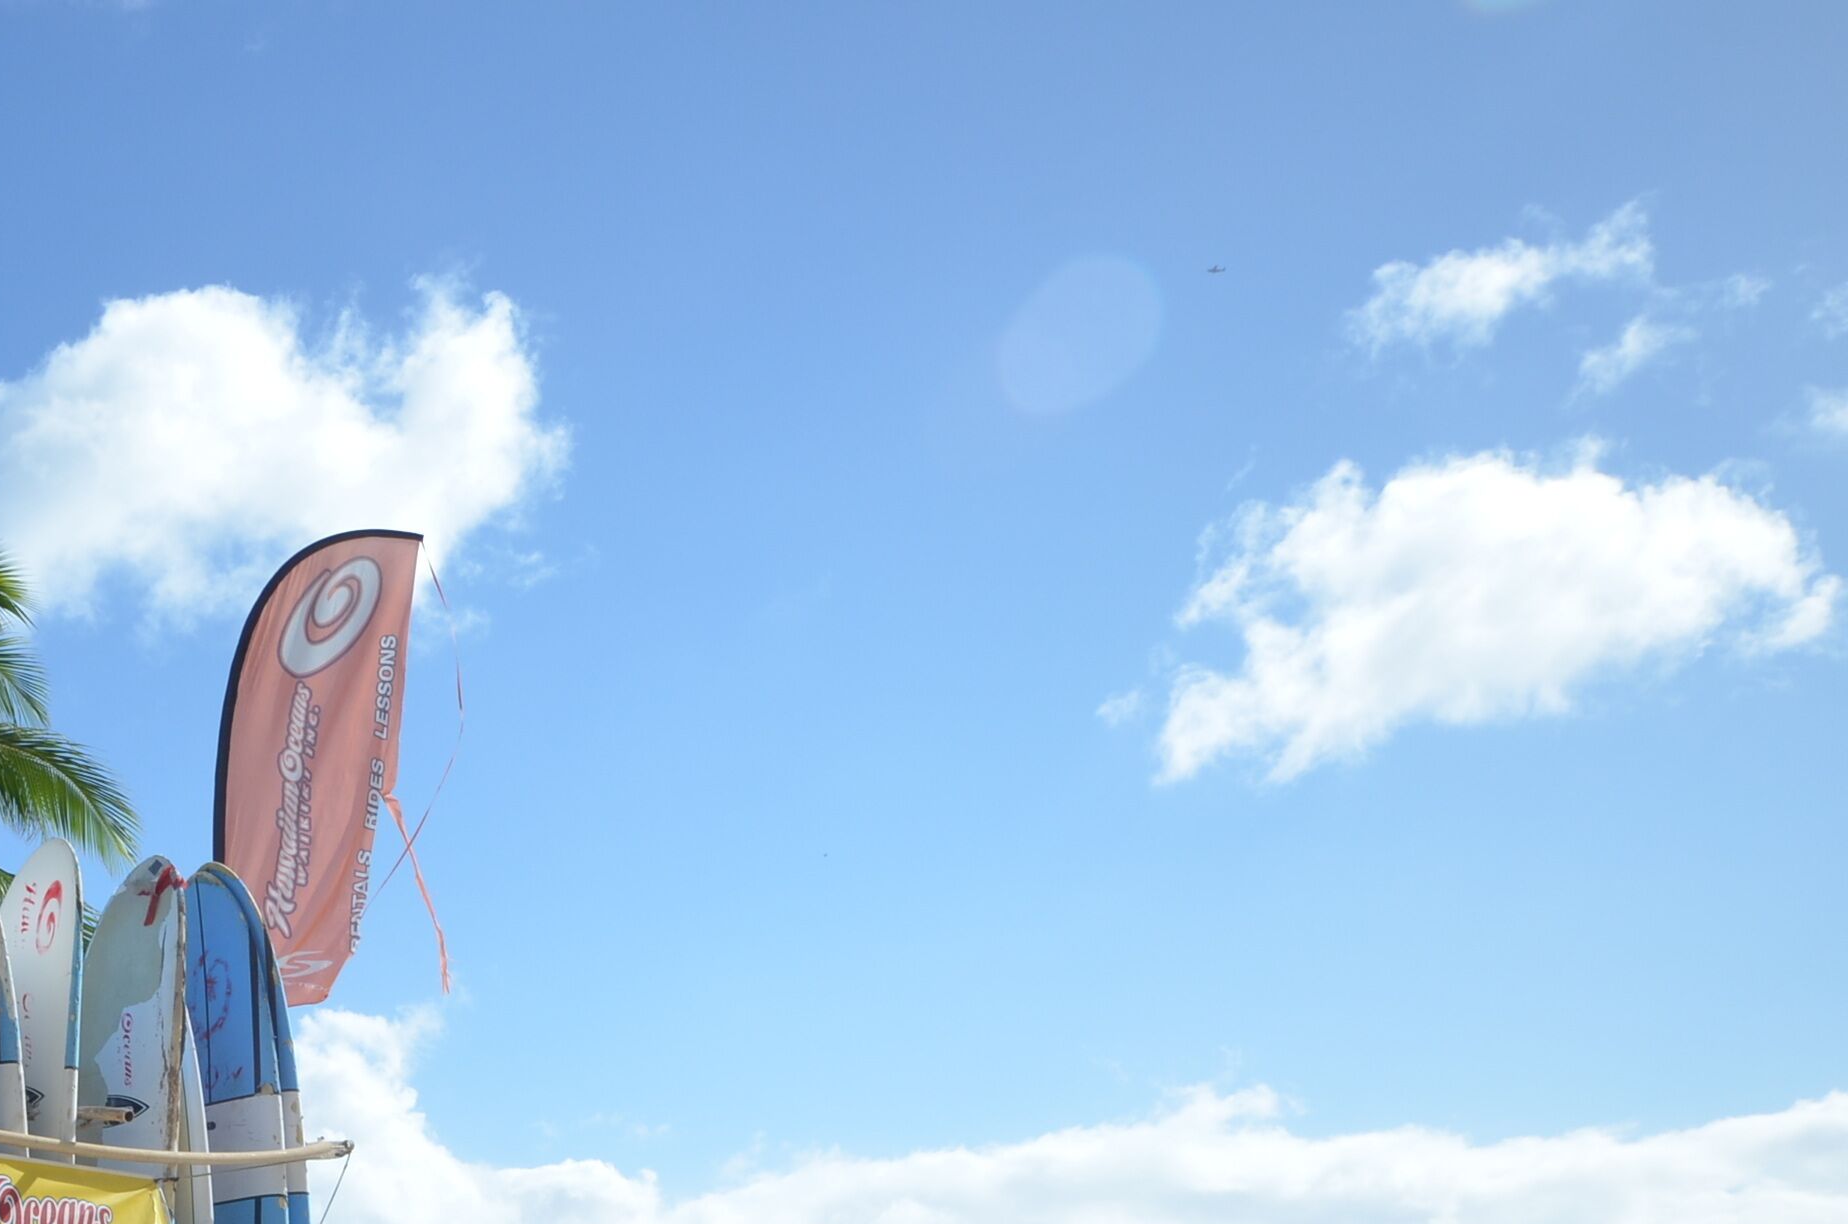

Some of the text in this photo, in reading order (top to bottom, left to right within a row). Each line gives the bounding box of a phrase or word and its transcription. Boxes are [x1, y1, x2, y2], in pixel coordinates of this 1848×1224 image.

[373, 633, 397, 740] LESSONS
[263, 680, 311, 938] Hawaiian Oceans
[364, 758, 385, 831] RIDES
